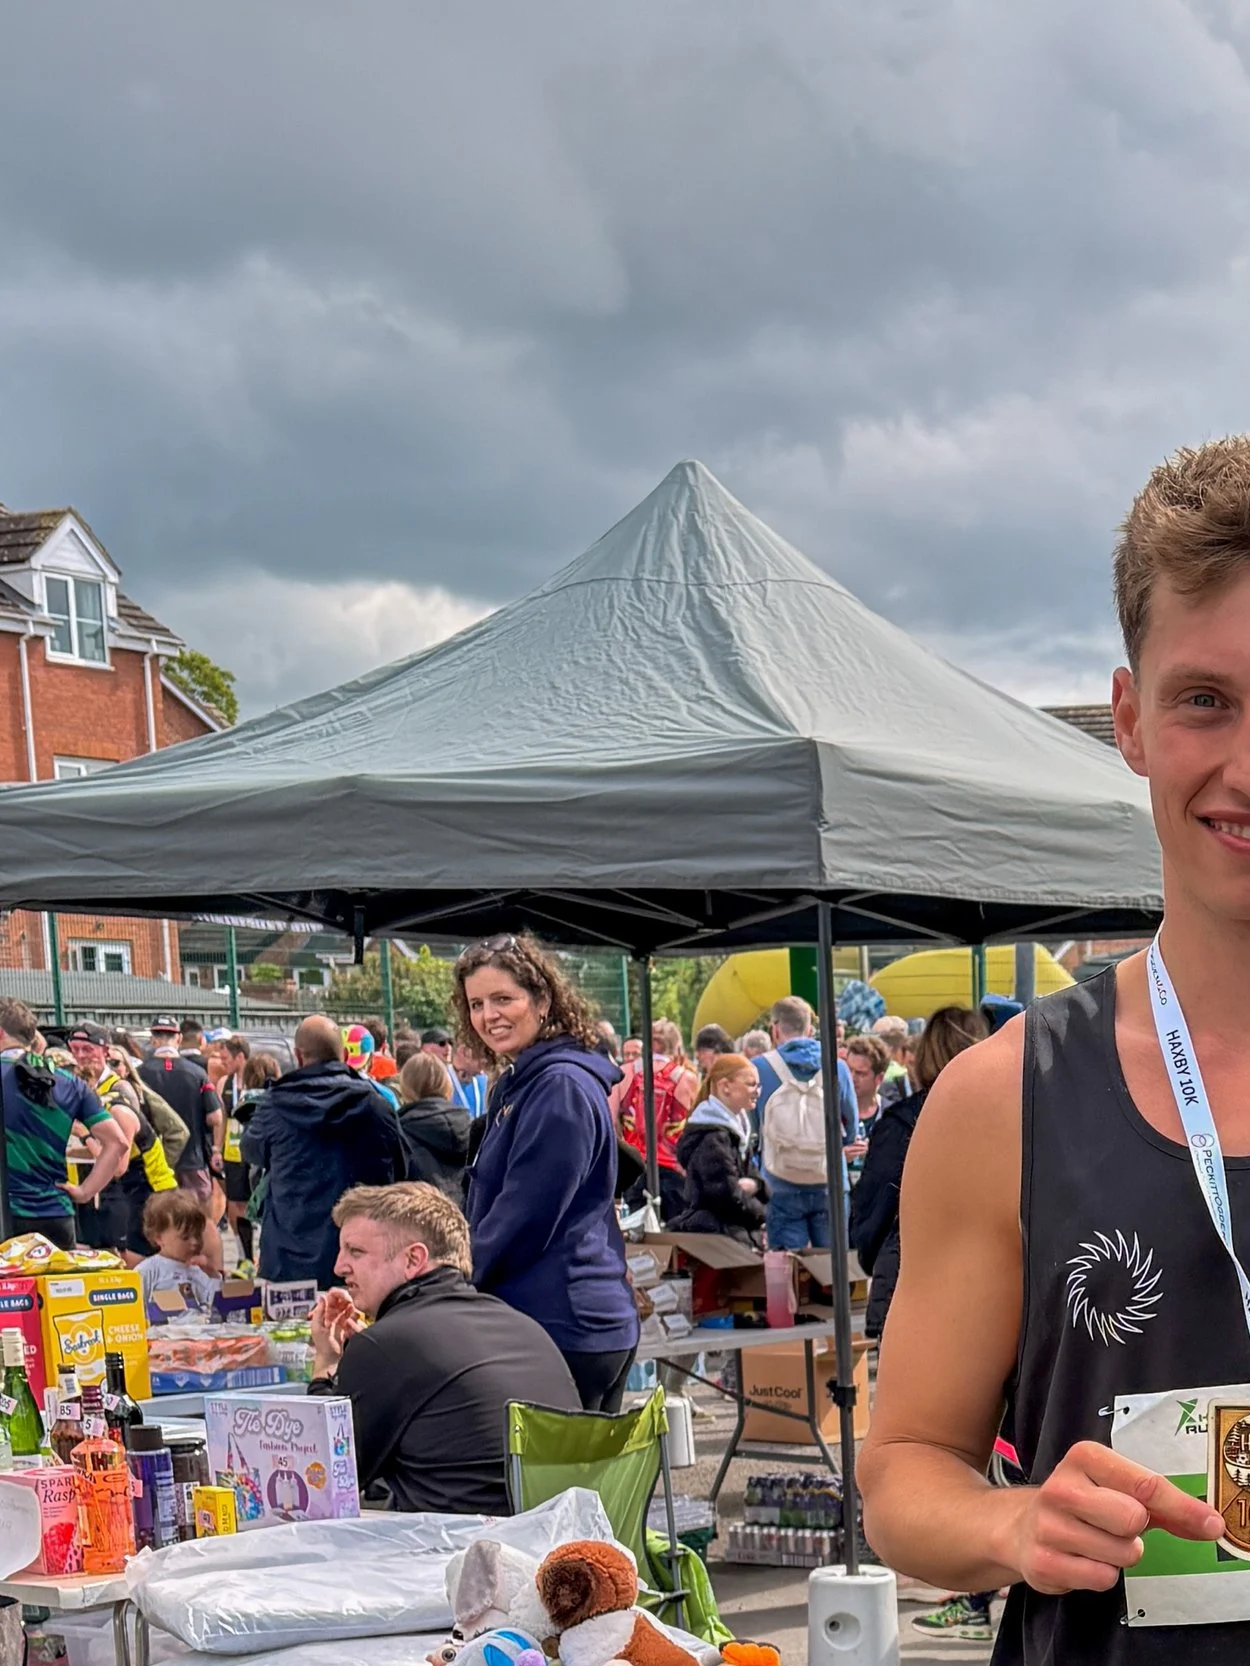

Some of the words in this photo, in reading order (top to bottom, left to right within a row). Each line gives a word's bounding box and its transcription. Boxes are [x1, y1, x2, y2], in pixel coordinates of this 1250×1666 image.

[1166, 1029, 1191, 1076] HAXBY
[1179, 1078, 1199, 1106] 10K
[263, 1408, 304, 1442] Dye
